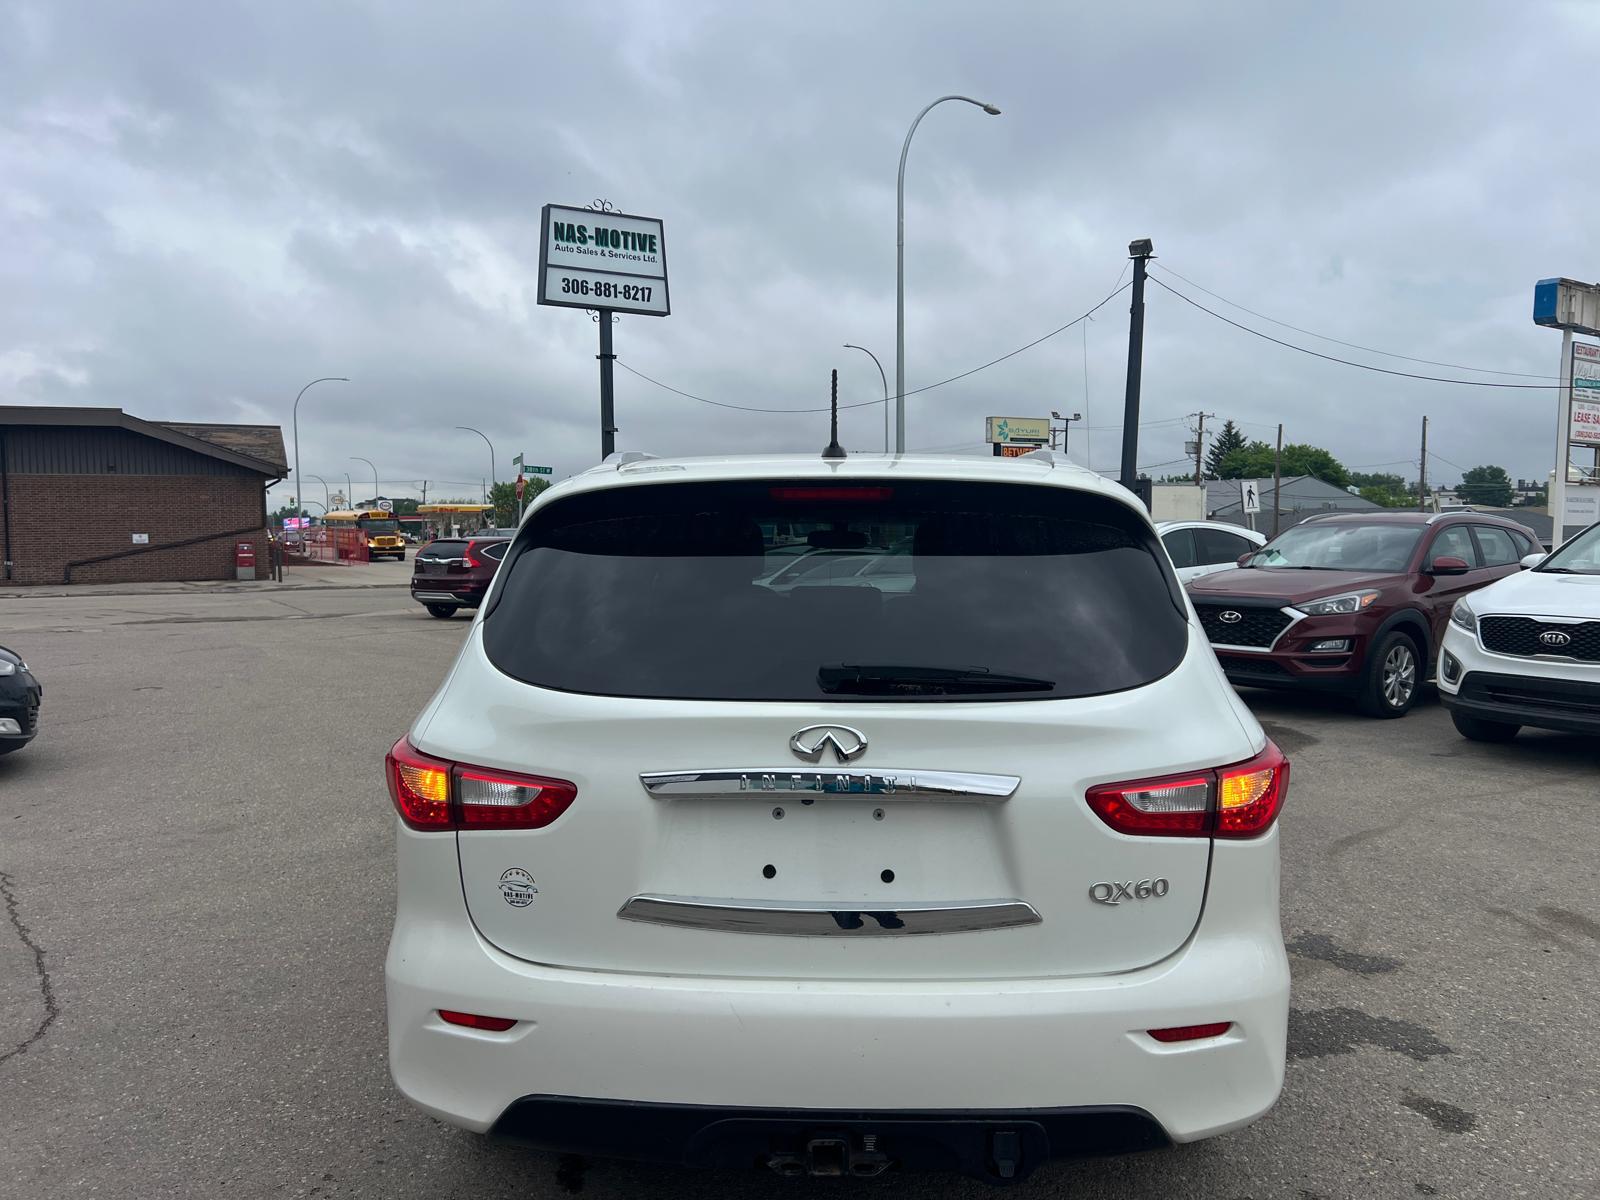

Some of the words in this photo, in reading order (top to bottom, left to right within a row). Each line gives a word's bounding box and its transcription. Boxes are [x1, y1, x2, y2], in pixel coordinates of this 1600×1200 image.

[554, 221, 658, 254] NAS-MOTIVE
[554, 243, 575, 253] Auto
[576, 246, 599, 256] Sales
[600, 249, 607, 257] &
[608, 250, 642, 262] Services
[643, 255, 658, 264] Ltd.
[561, 277, 652, 303] 306-881-8217
[1573, 411, 1592, 424] LEASE
[1543, 634, 1565, 644] KIA
[739, 774, 917, 794] INFINITI
[1088, 877, 1170, 906] QX60
